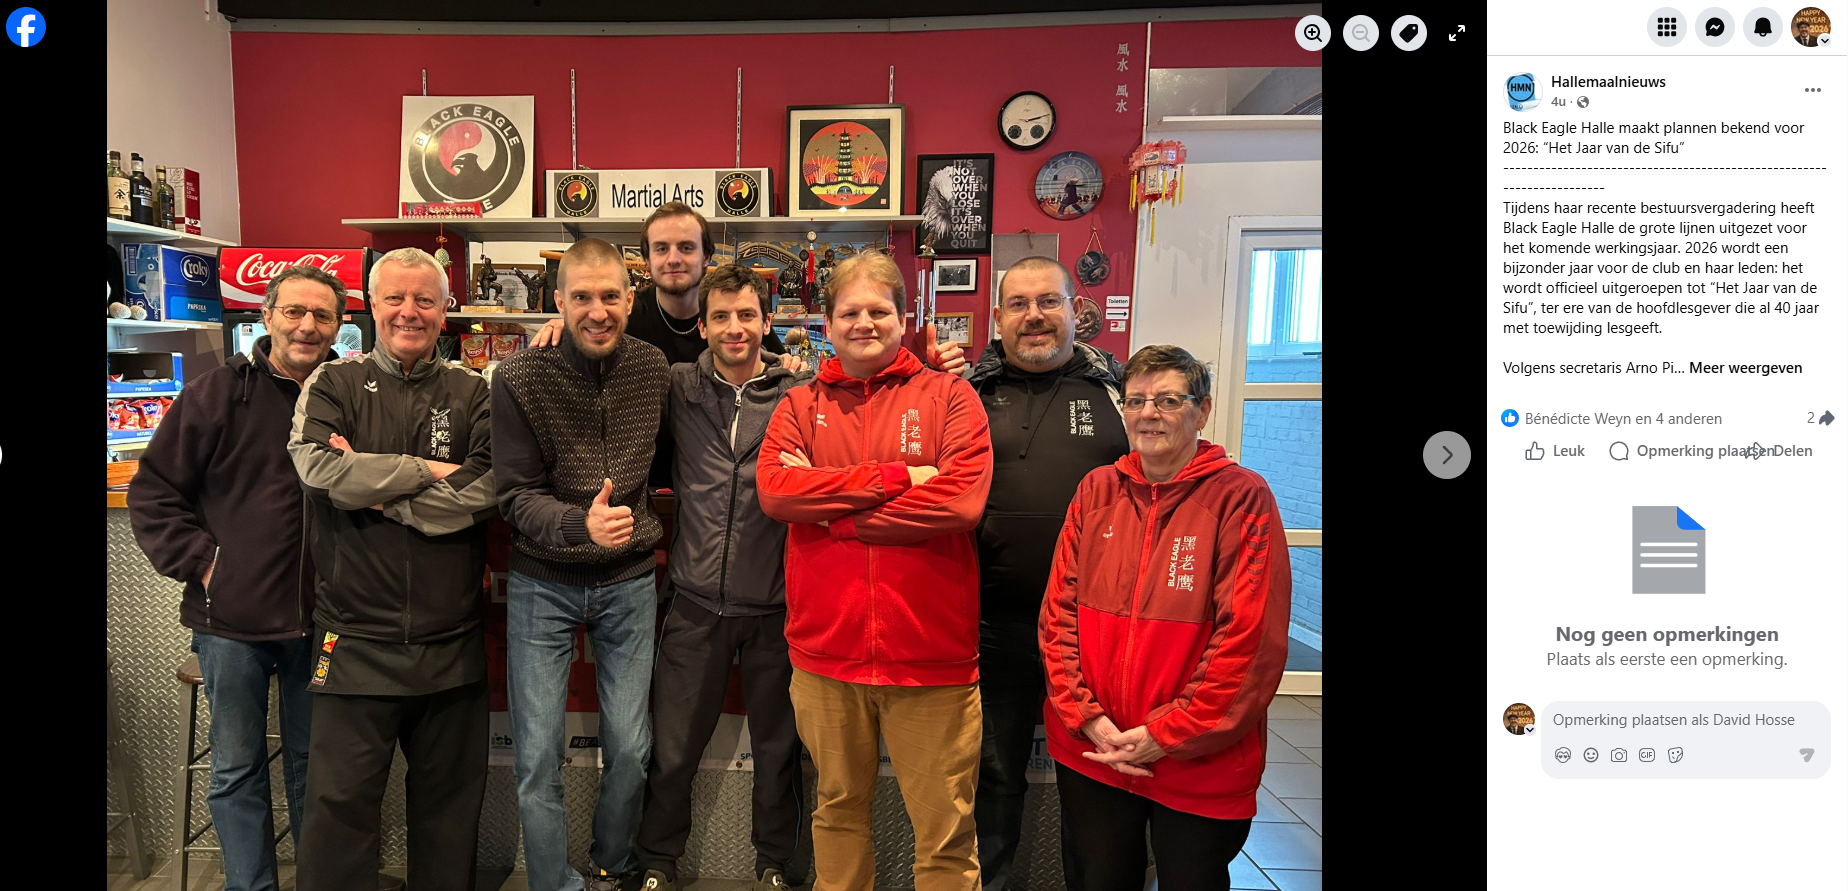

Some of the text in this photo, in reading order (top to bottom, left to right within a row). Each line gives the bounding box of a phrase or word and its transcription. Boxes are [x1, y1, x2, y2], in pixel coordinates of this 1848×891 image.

[473, 106, 520, 147] EAGLE
[953, 159, 973, 168] IT'S
[953, 167, 976, 176] NOT
[952, 175, 983, 184] OVER
[952, 184, 987, 192] WHEN
[611, 183, 704, 208] Martial Arts
[952, 191, 976, 200] YOU
[952, 199, 980, 208] LOSE
[951, 208, 972, 216] IT'S
[951, 216, 982, 224] OVER
[951, 223, 986, 232] WHEN
[951, 231, 974, 240] YOU
[950, 240, 977, 249] QUIT
[183, 259, 208, 278] Croky
[1167, 537, 1181, 587] BLACK EAGLE
